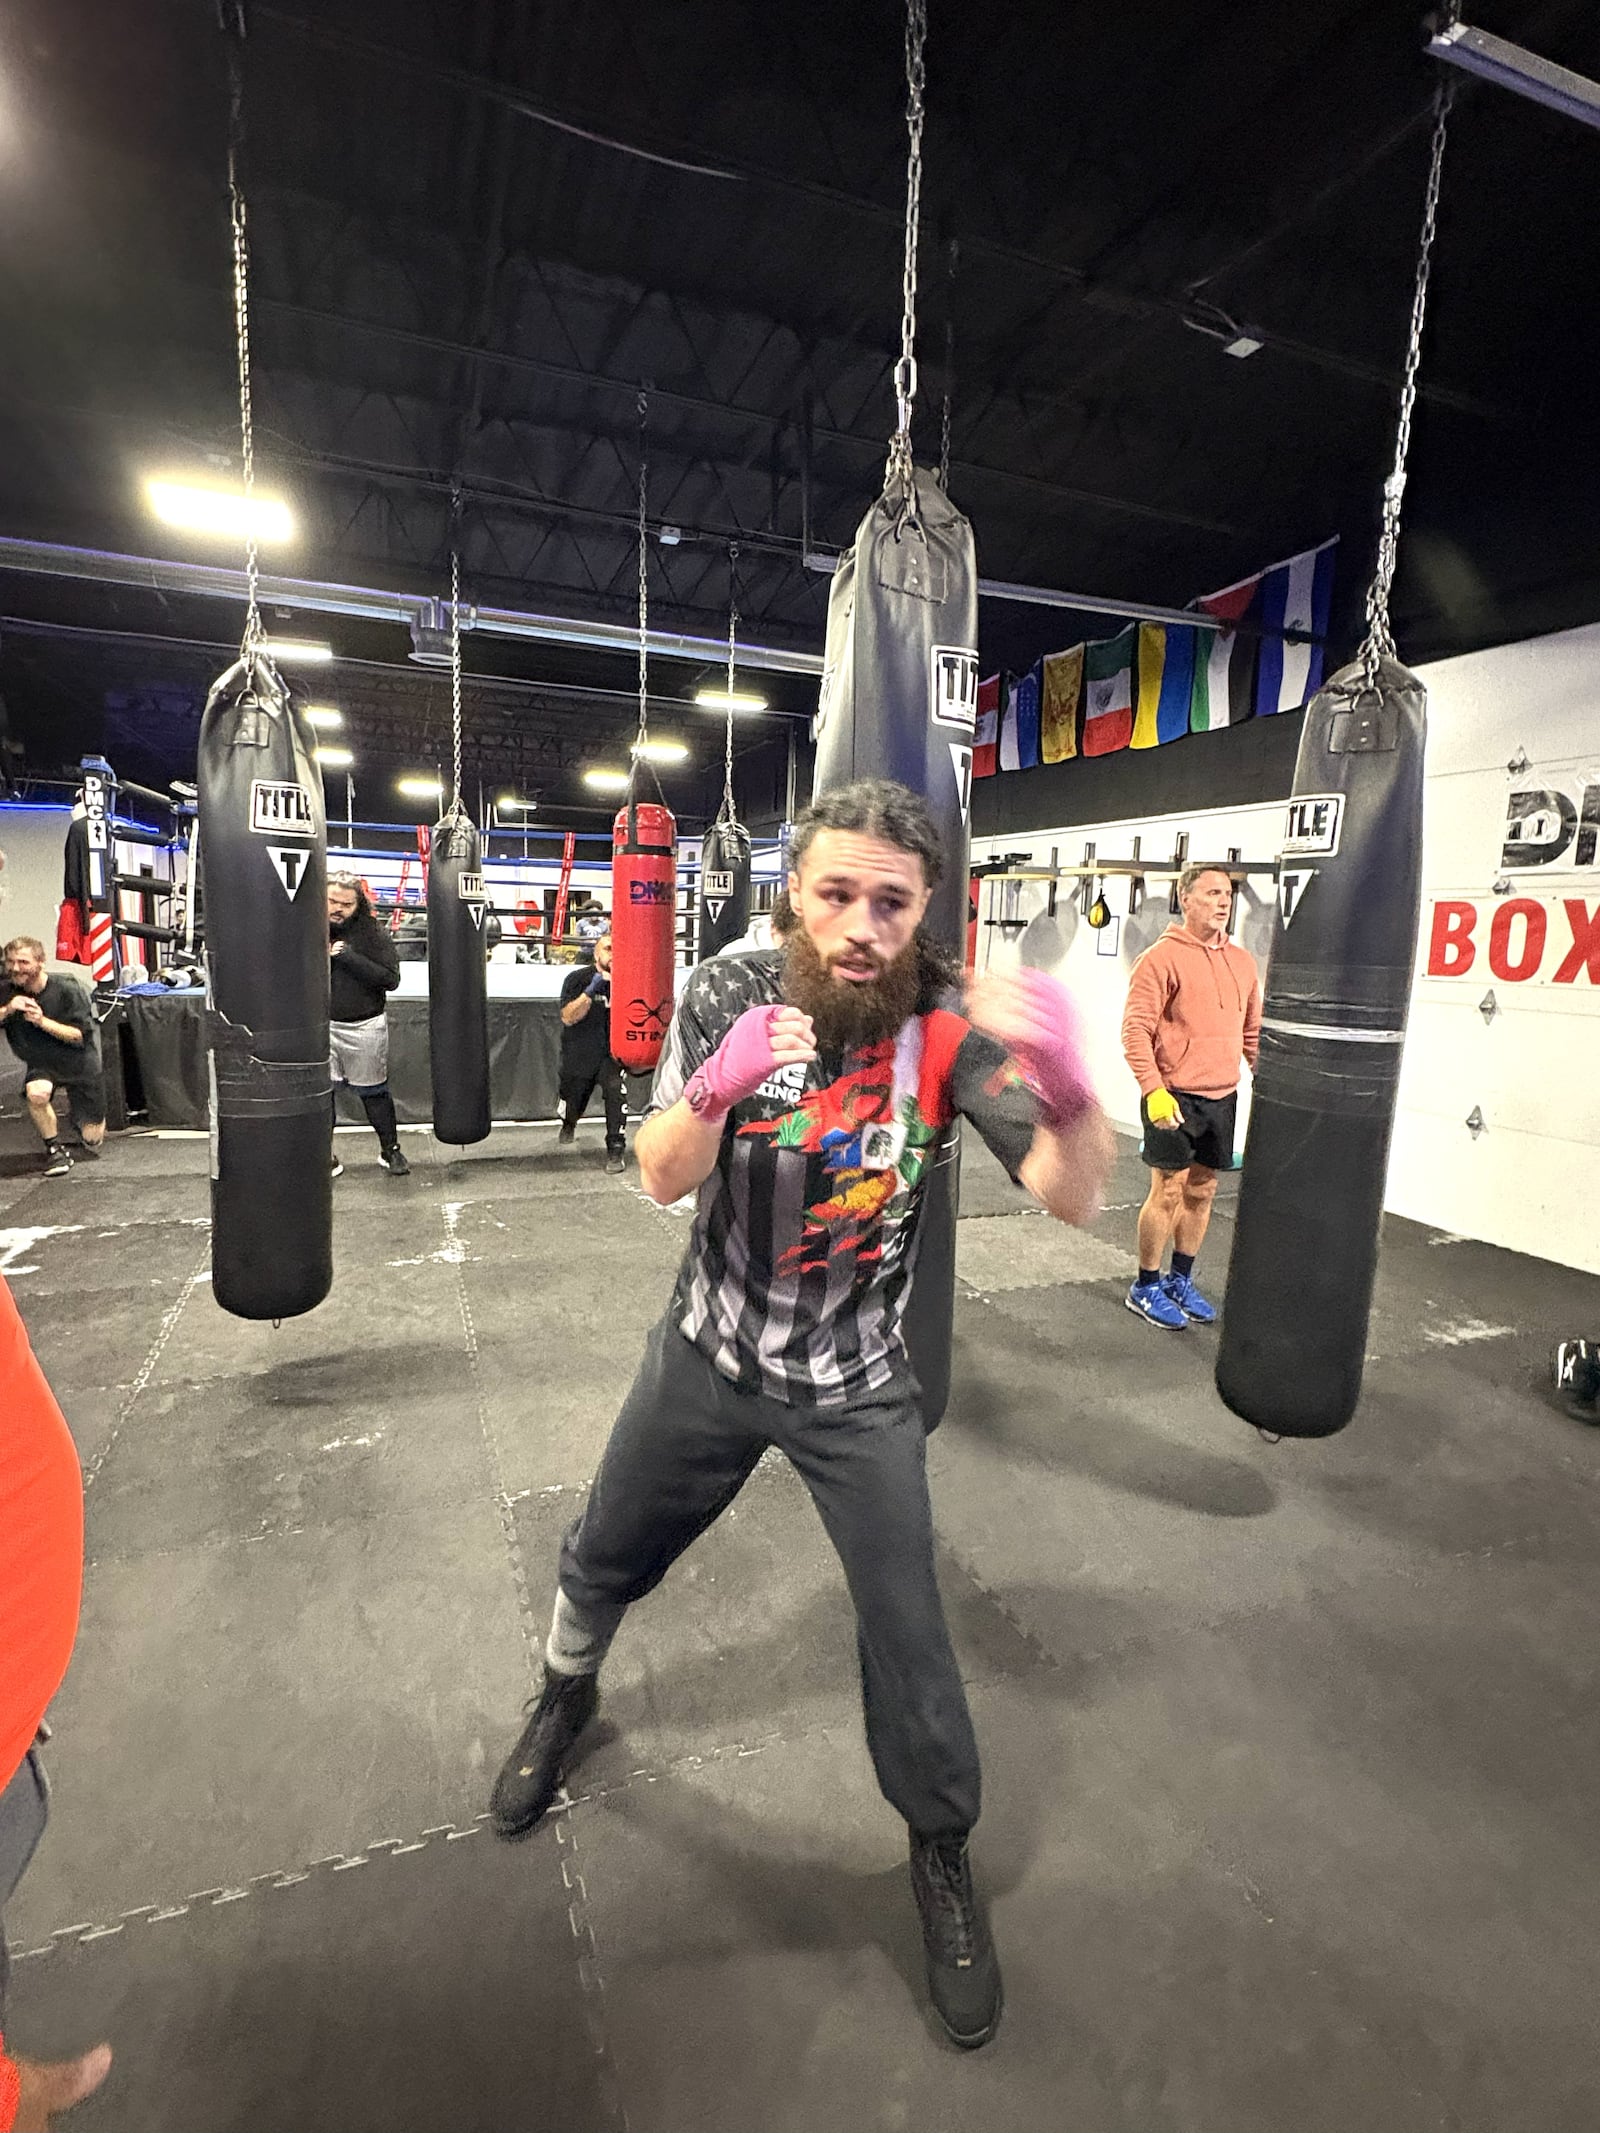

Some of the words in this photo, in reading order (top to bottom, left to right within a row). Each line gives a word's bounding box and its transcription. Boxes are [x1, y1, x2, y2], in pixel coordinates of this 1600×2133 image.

[85, 776, 104, 820] DMC
[961, 752, 971, 809] T
[280, 852, 301, 890] T
[474, 906, 481, 925] T
[711, 902, 719, 919] T
[1283, 875, 1299, 917] T
[1427, 898, 1600, 985] BOX
